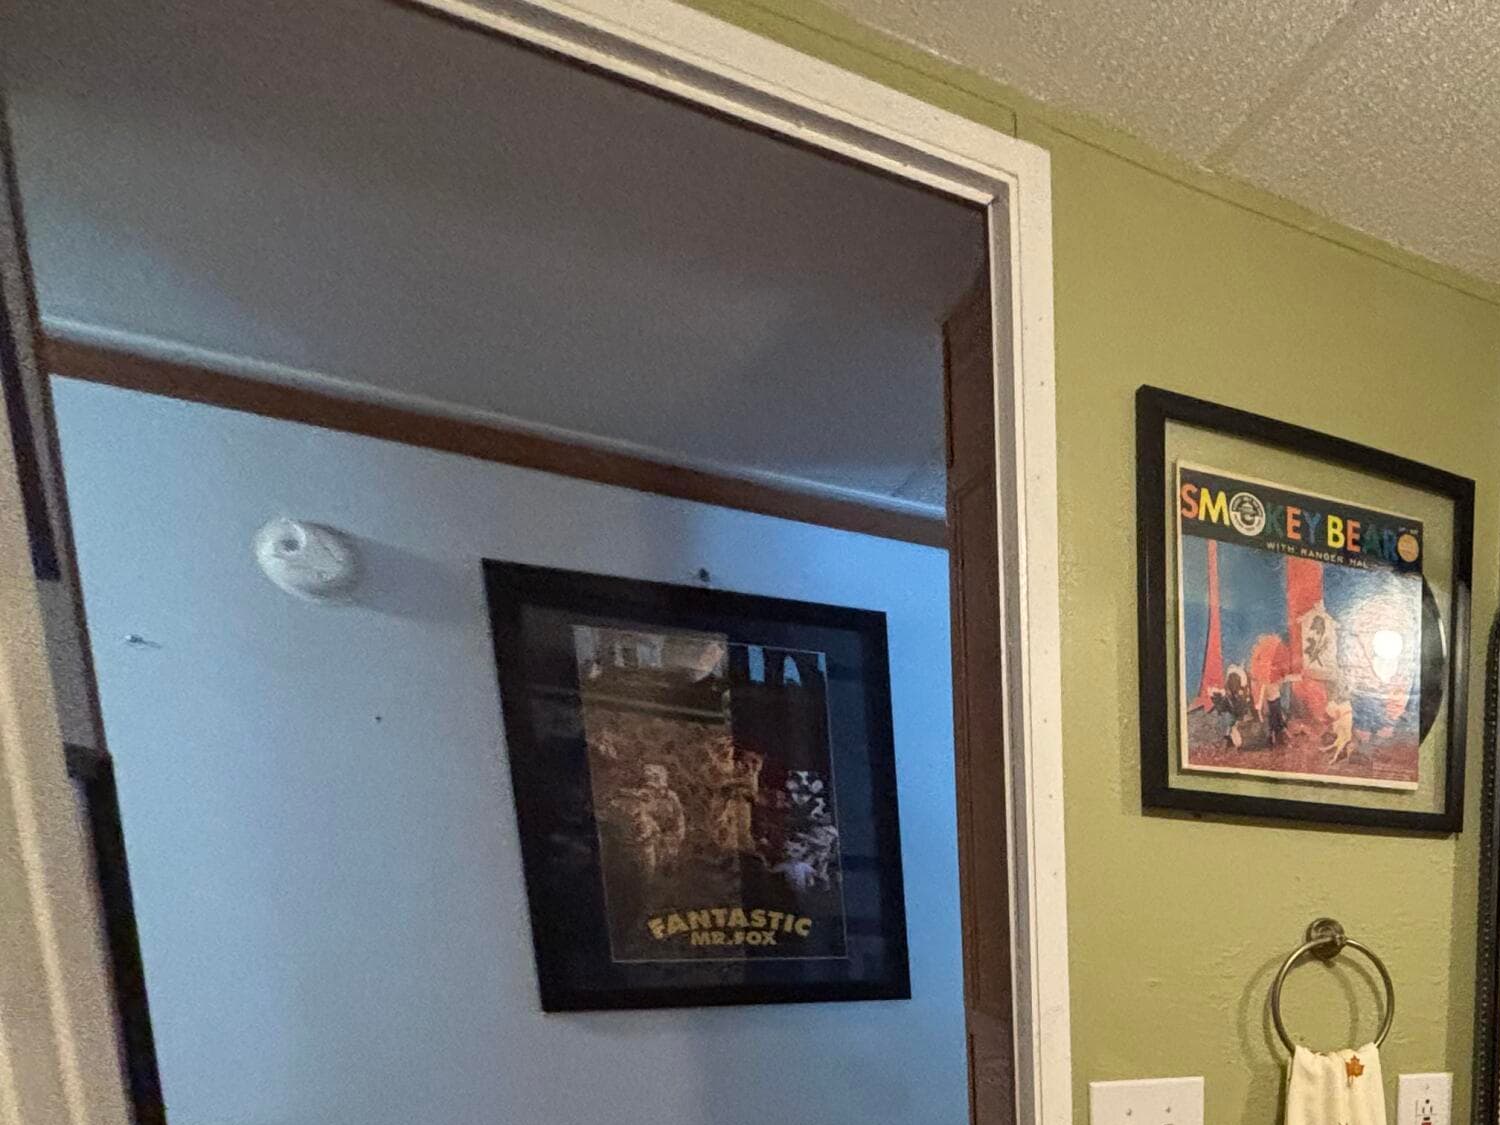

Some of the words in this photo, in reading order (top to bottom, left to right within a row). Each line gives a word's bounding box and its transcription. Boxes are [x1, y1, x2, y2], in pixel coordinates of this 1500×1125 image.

[1266, 541, 1295, 554] WITH
[1301, 549, 1344, 564] RANGER
[1350, 558, 1370, 568] HAL
[647, 907, 812, 940] FANTASTIC
